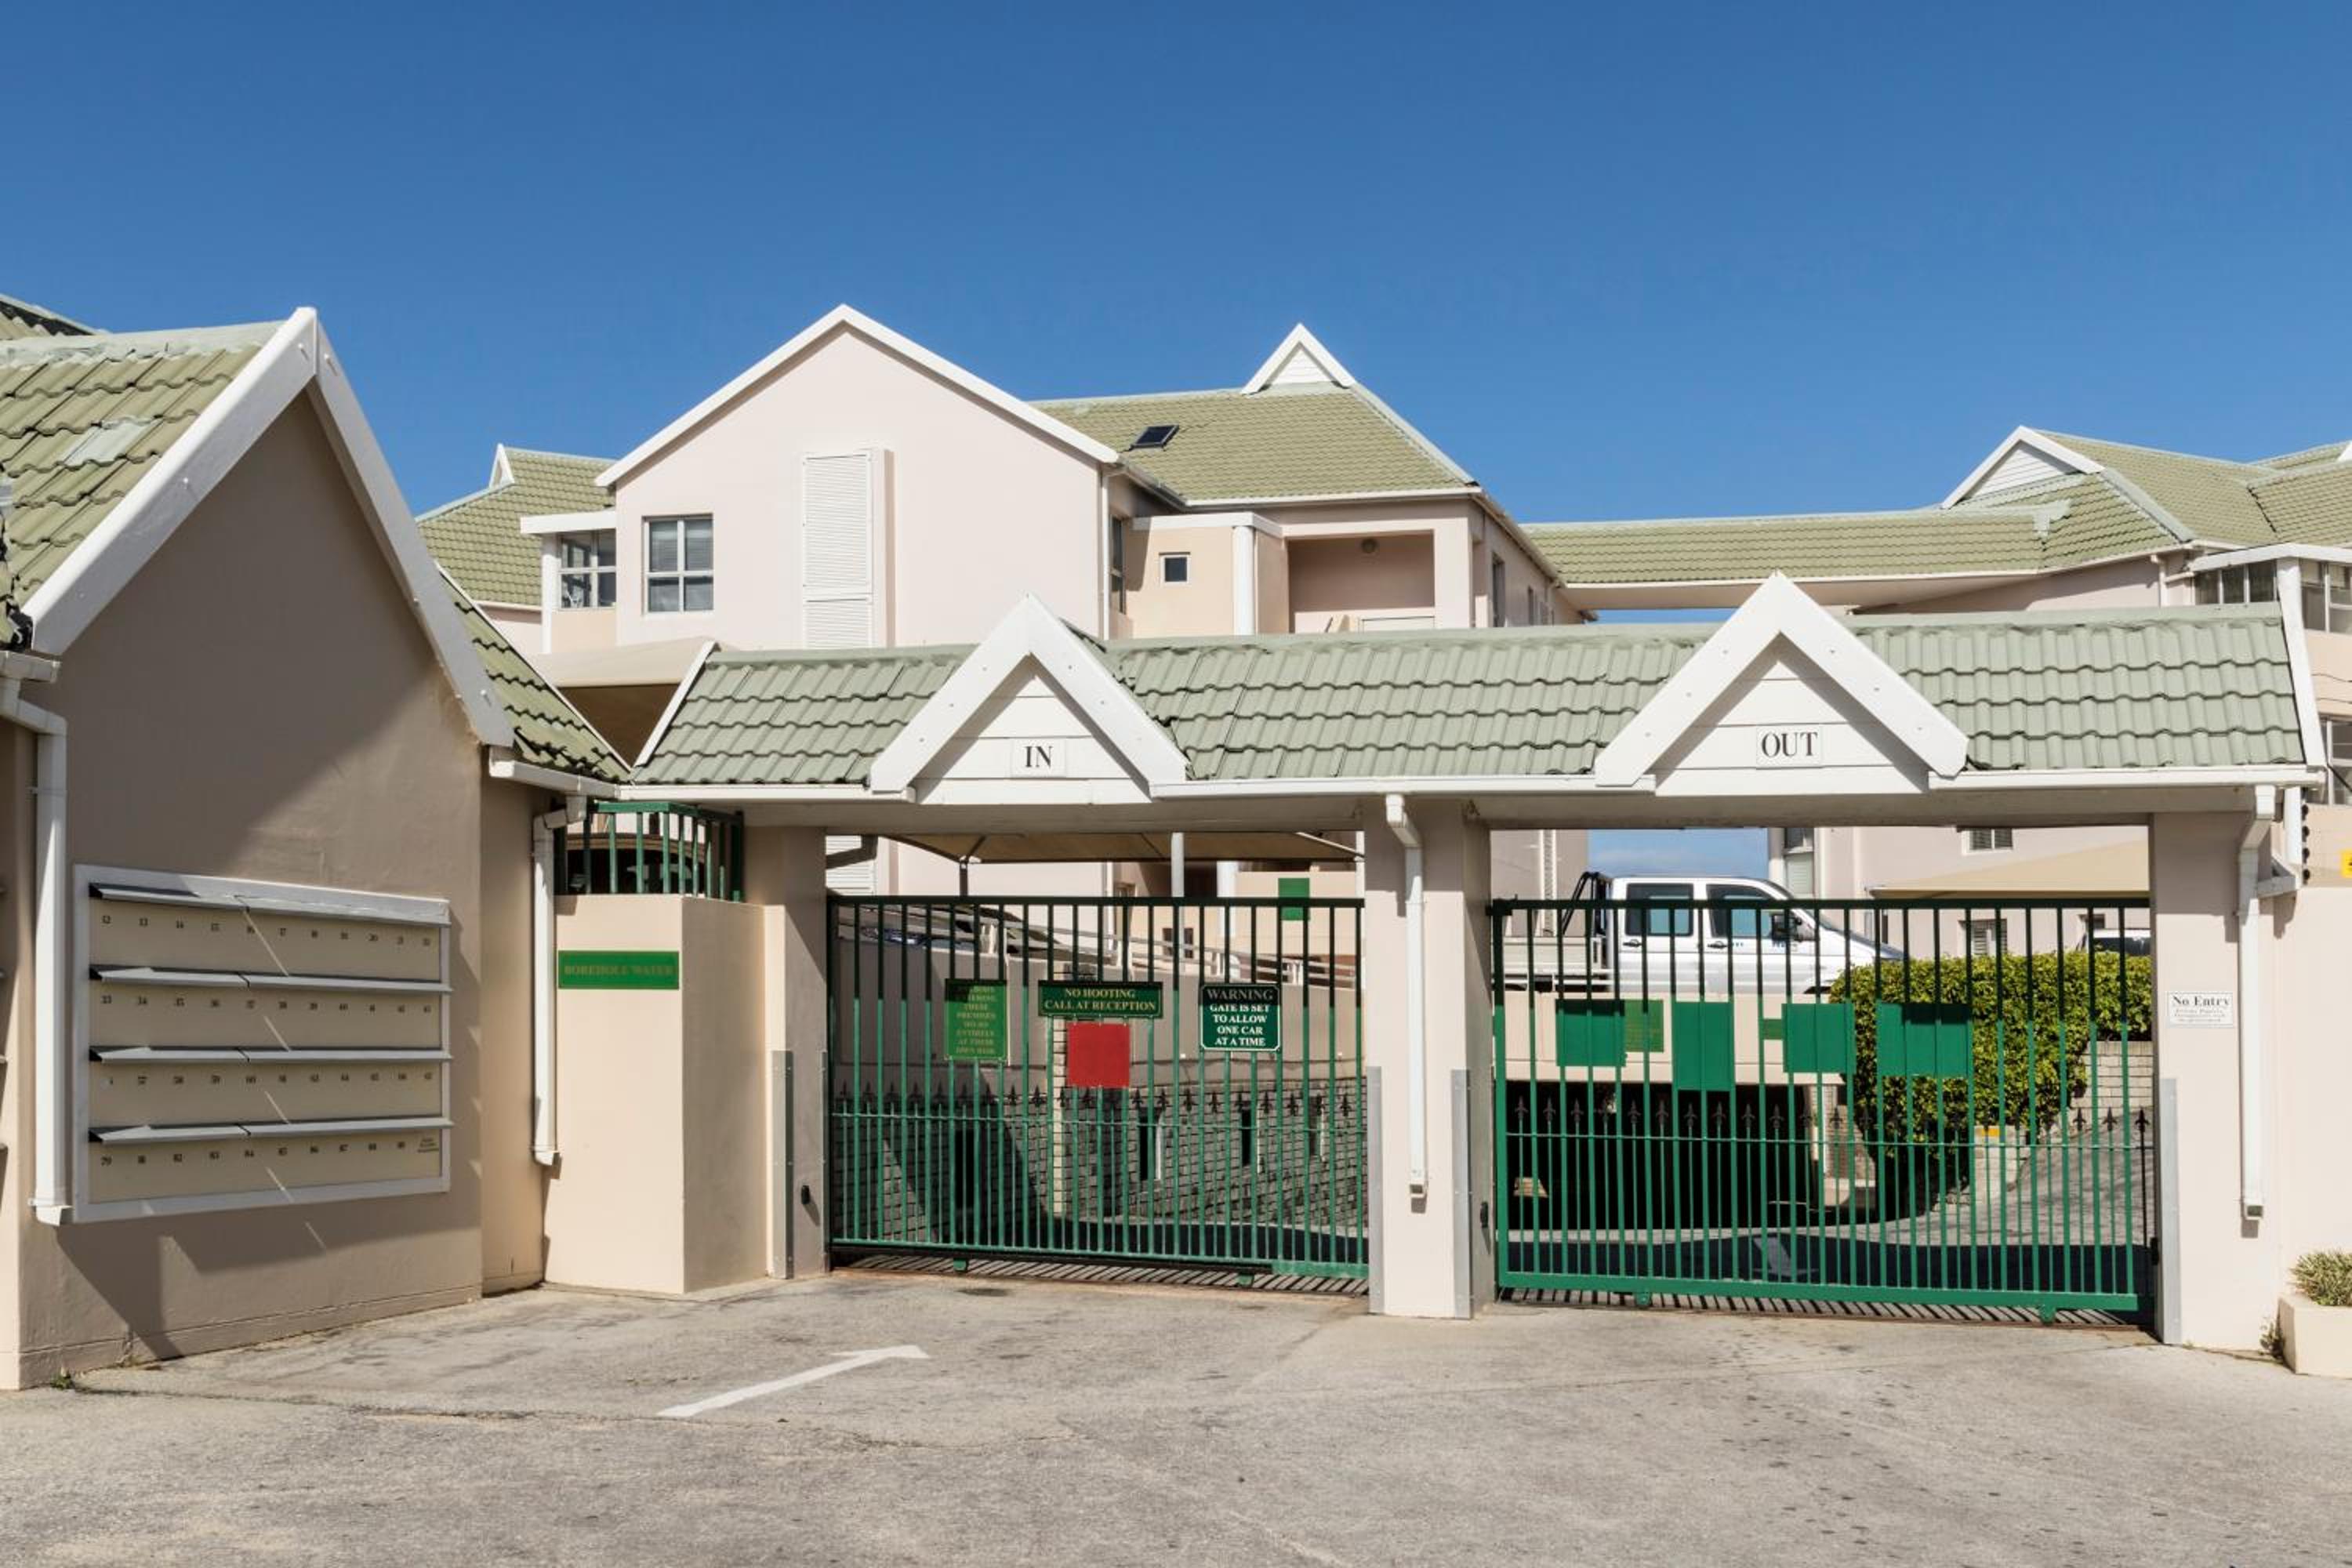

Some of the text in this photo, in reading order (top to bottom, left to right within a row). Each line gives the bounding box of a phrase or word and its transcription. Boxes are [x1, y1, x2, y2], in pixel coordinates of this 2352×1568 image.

[1761, 731, 1818, 757] OUT
[1024, 746, 1054, 768] IN
[1065, 988, 1136, 998] NO HOOTING
[1207, 989, 1273, 1000] WARNING
[1044, 1000, 1155, 1011] CALL AT RECEPTION
[2172, 996, 2230, 1008] No Entry
[1212, 1014, 1267, 1023] TO ALLOW
[1217, 1025, 1263, 1035] ONE CAR
[1214, 1037, 1266, 1046] AT A TIME
